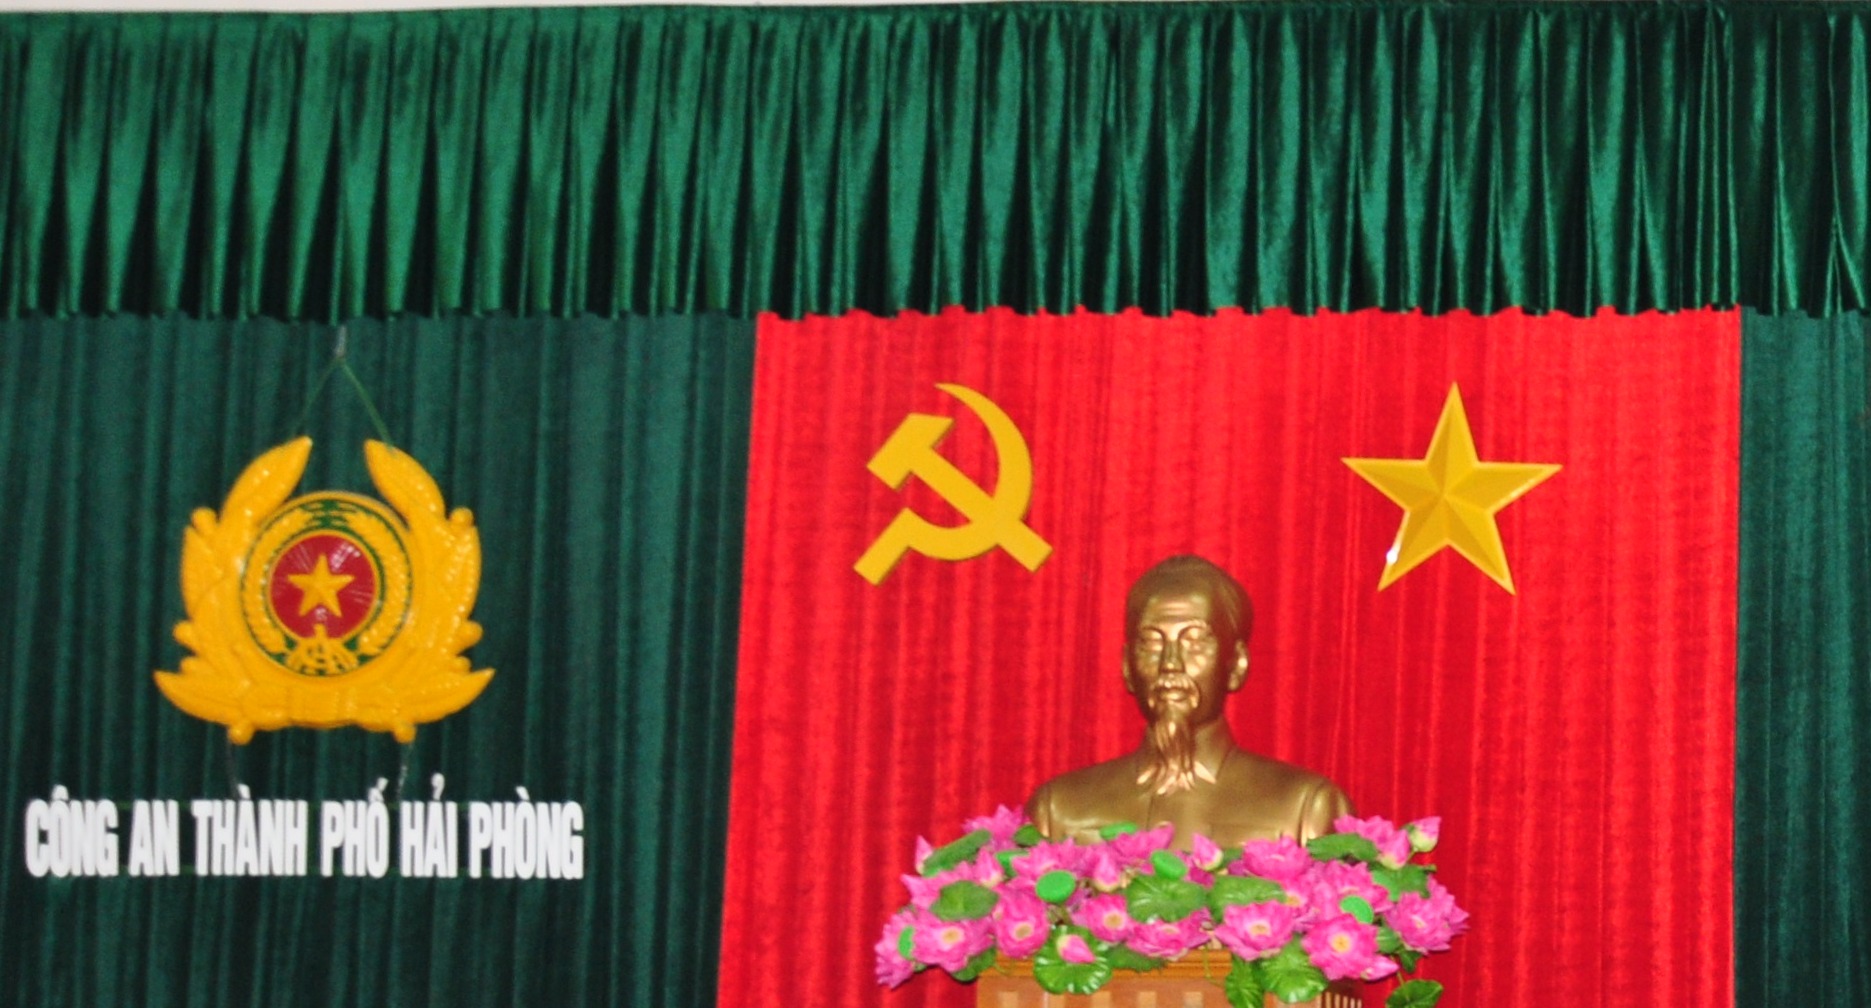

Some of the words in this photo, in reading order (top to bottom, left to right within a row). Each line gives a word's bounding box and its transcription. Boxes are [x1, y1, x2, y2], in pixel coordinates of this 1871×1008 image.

[26, 786, 118, 877] CÔNG
[129, 800, 179, 876] AN
[192, 785, 307, 875] THÀNH
[321, 778, 389, 877] PHỐ
[401, 774, 457, 877] HẢI
[469, 787, 583, 879] PHÒNG
